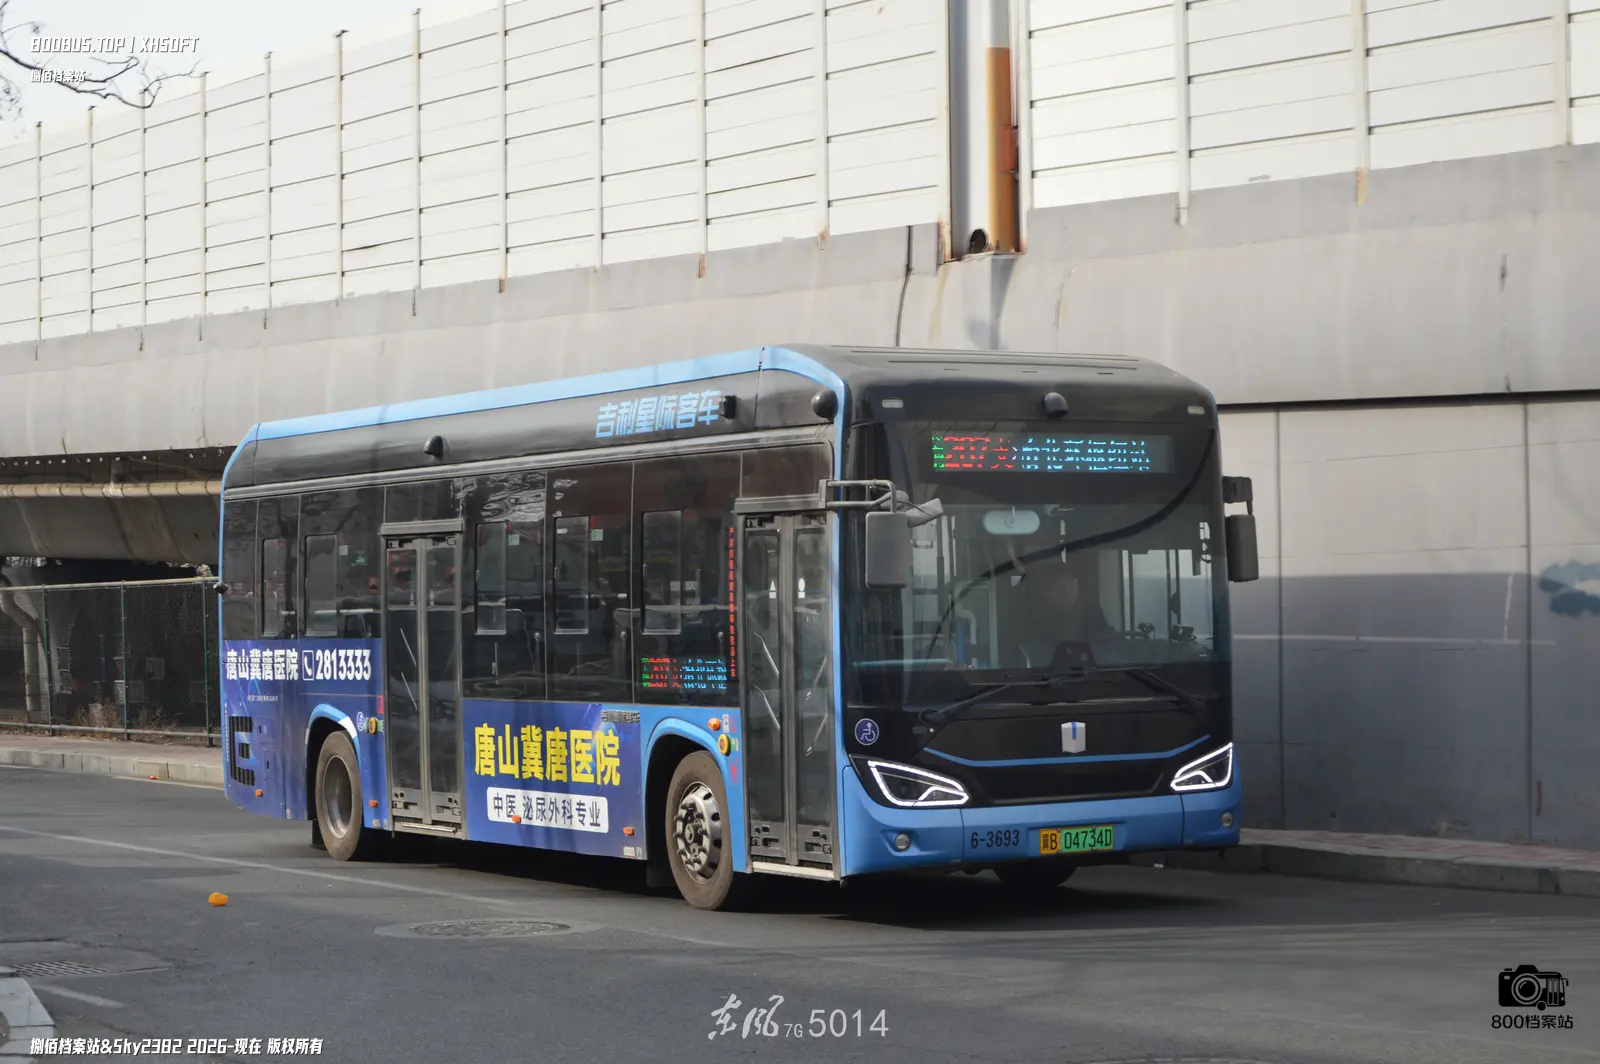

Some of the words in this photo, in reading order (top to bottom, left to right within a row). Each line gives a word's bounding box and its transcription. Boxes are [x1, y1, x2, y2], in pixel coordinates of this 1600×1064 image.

[595, 389, 721, 438] 吉利星际客车
[226, 647, 299, 681] 唐山冀唐医院
[315, 648, 372, 681] 2813333
[474, 722, 622, 786] 唐山冀唐医院
[493, 792, 517, 818] 中医
[522, 795, 601, 828] 泌尿外科专业
[970, 829, 1020, 849] 6-3693
